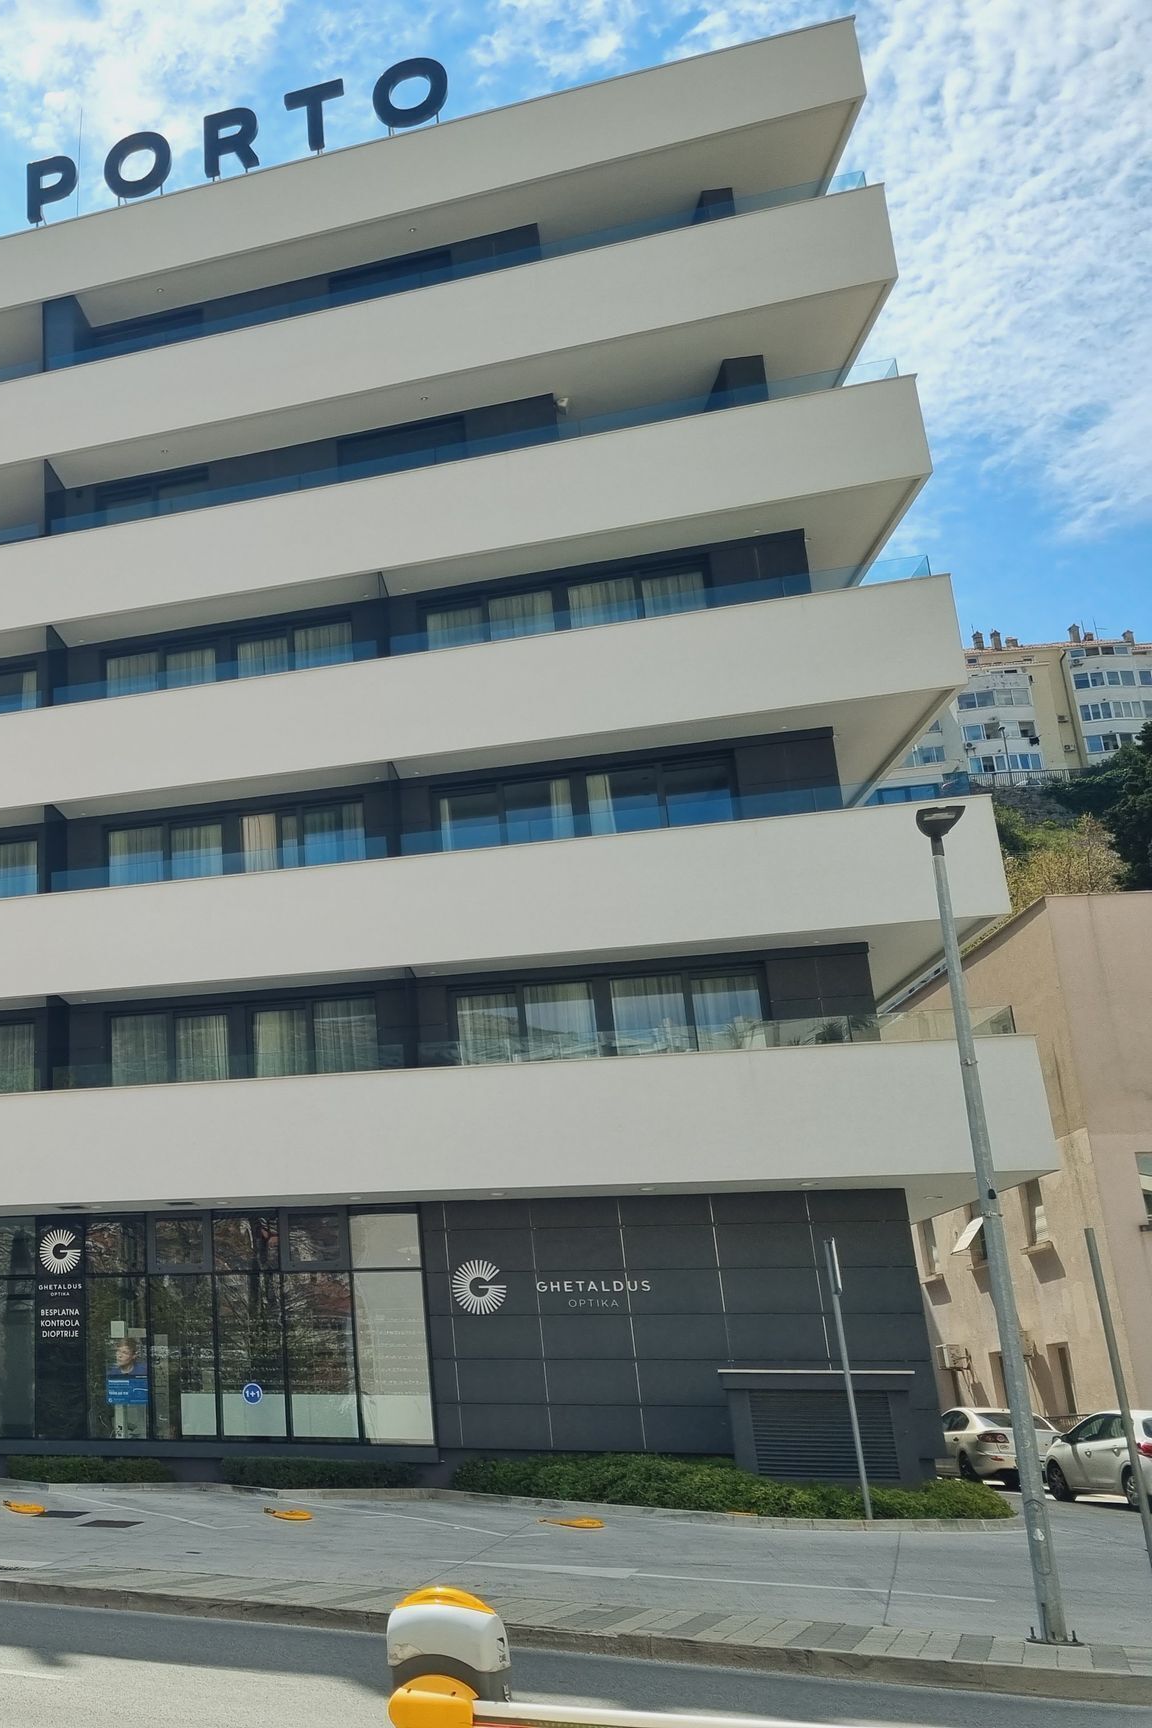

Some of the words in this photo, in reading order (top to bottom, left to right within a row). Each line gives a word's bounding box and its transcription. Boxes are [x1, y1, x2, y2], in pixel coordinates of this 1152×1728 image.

[26, 57, 449, 224] PORTO
[536, 1280, 651, 1292] GHETALDUS
[568, 1299, 619, 1308] OPTIKA
[40, 1308, 80, 1316] BESPLATNA
[40, 1319, 80, 1327] KONTROLA
[42, 1330, 79, 1338] DIOPTRIJE
[245, 1390, 260, 1398] 1+1
